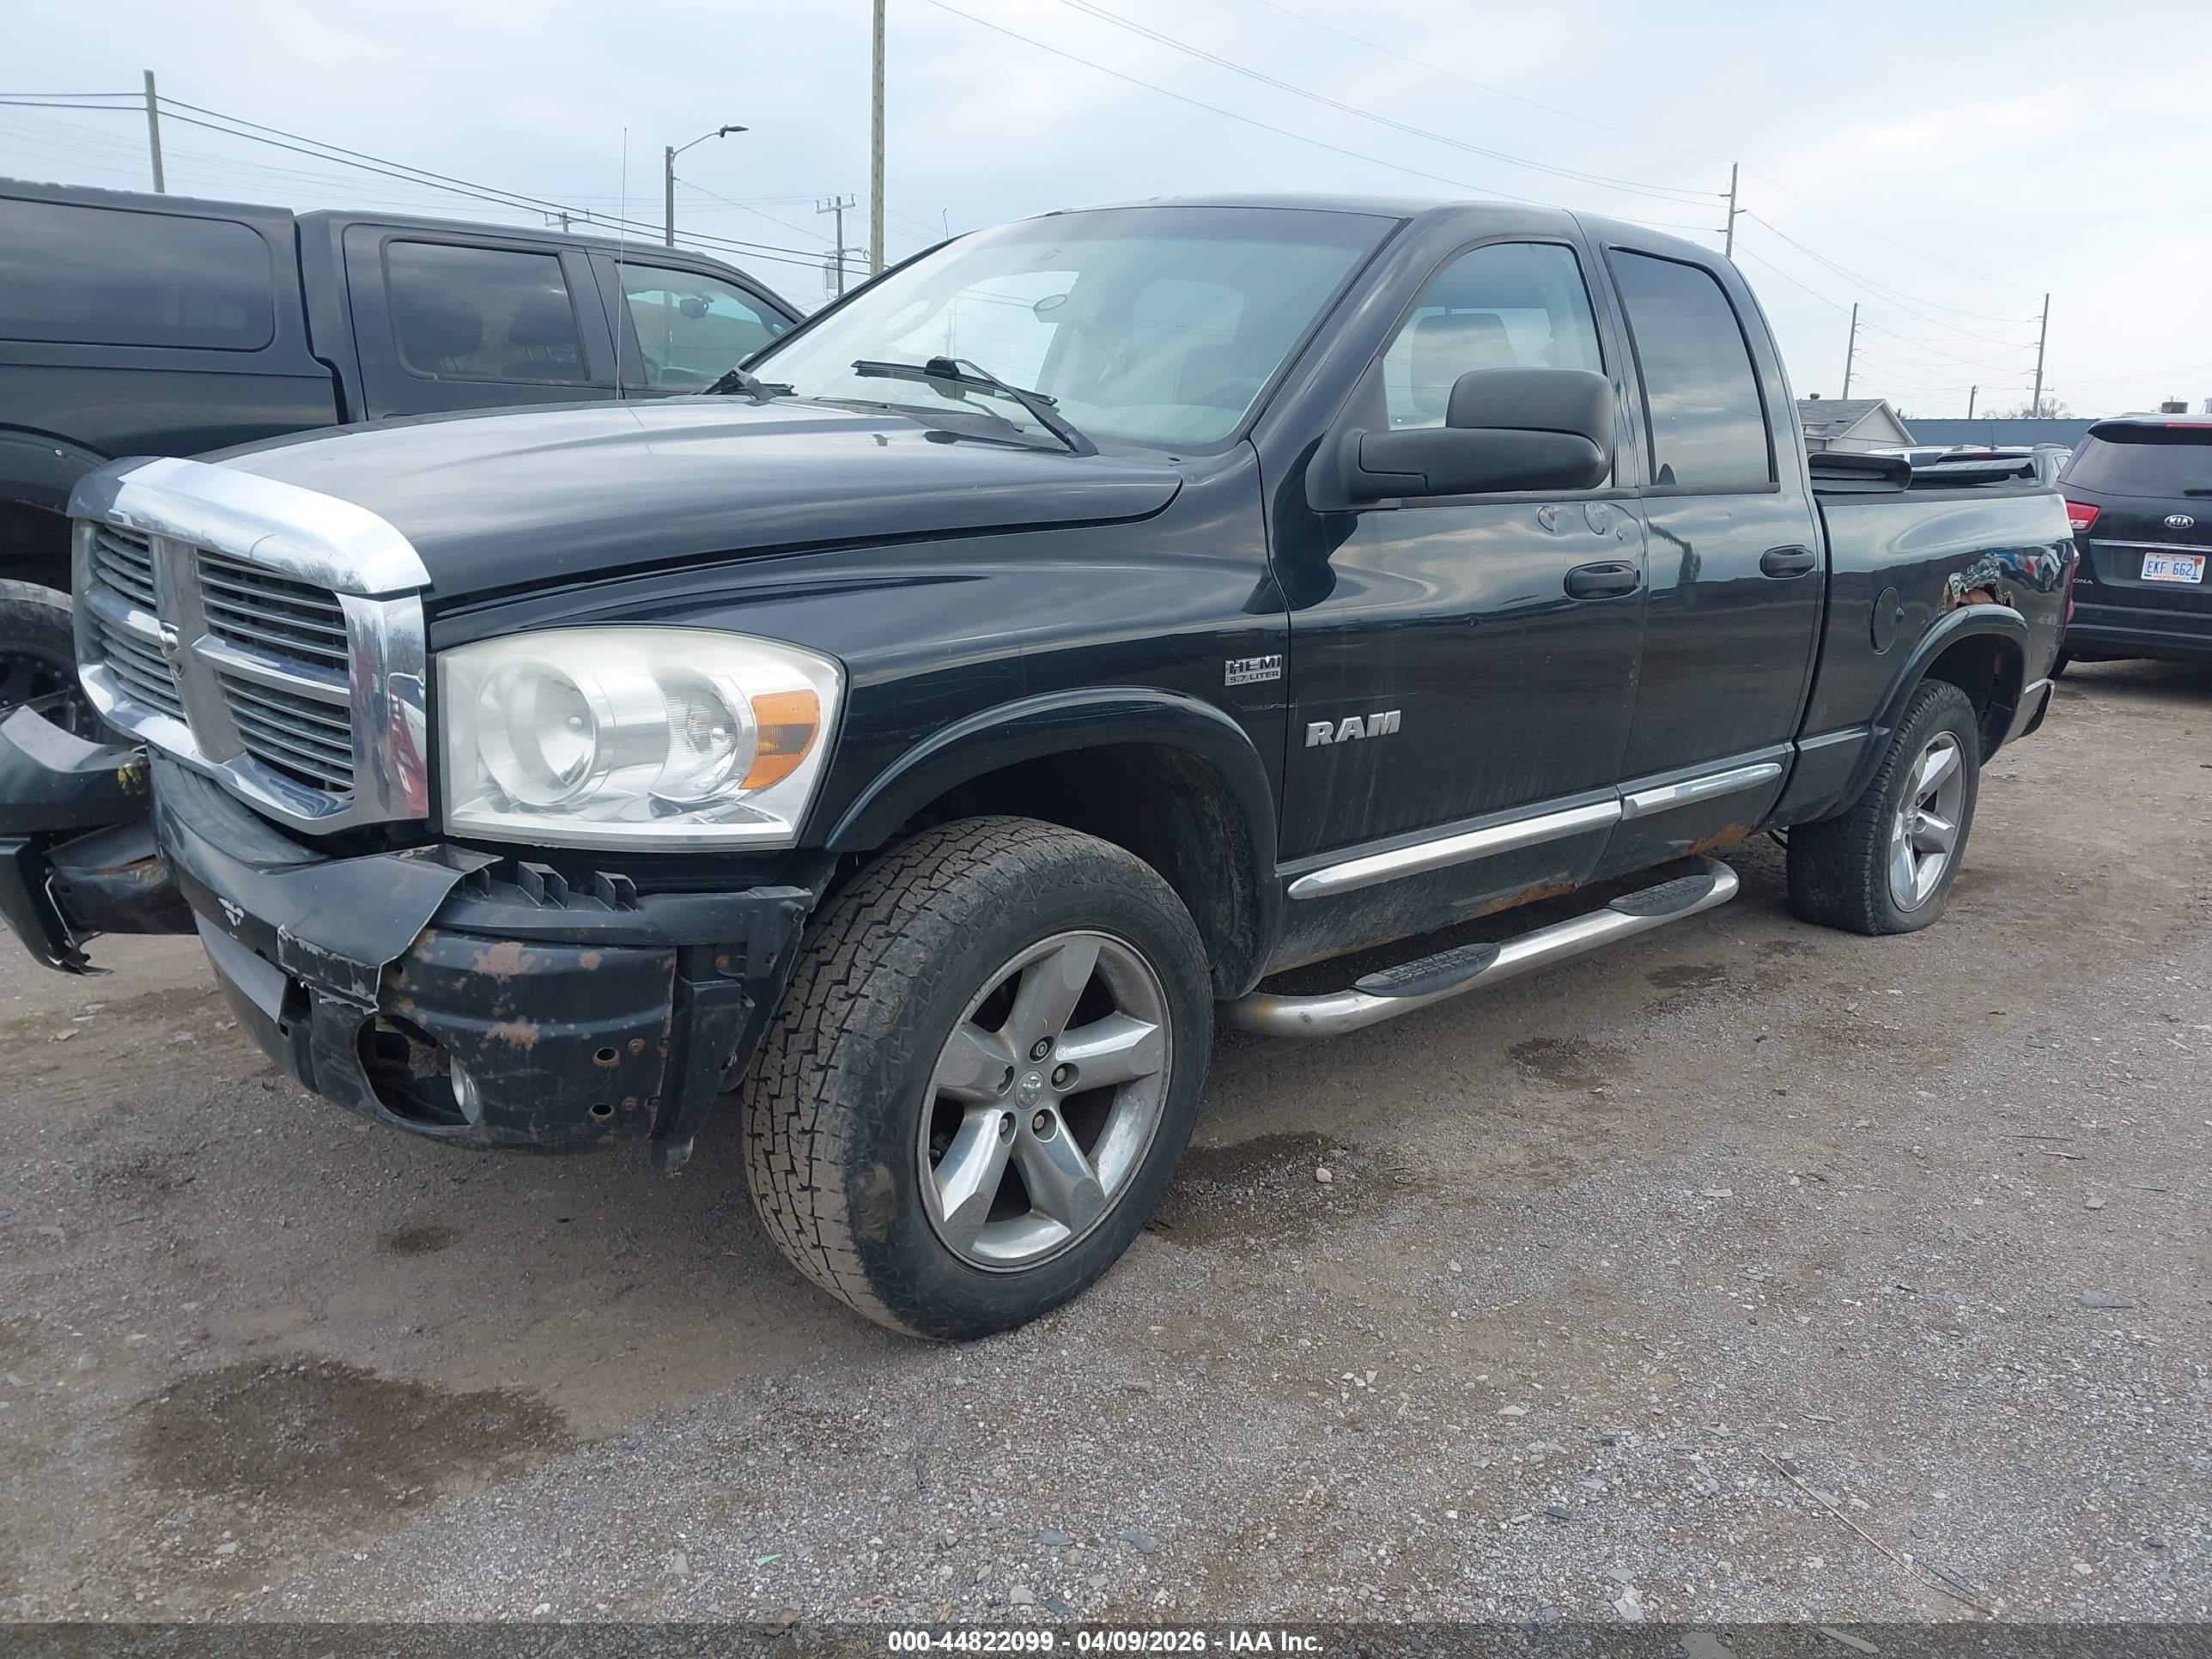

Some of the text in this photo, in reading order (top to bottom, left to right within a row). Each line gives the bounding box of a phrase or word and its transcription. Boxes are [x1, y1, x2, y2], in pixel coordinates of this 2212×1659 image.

[2168, 517, 2189, 526] KIA
[2147, 561, 2199, 576] EKF 6621
[1226, 654, 1281, 674] HEMI
[1229, 671, 1279, 684] 5.7 LITER
[1305, 709, 1401, 748] RAM
